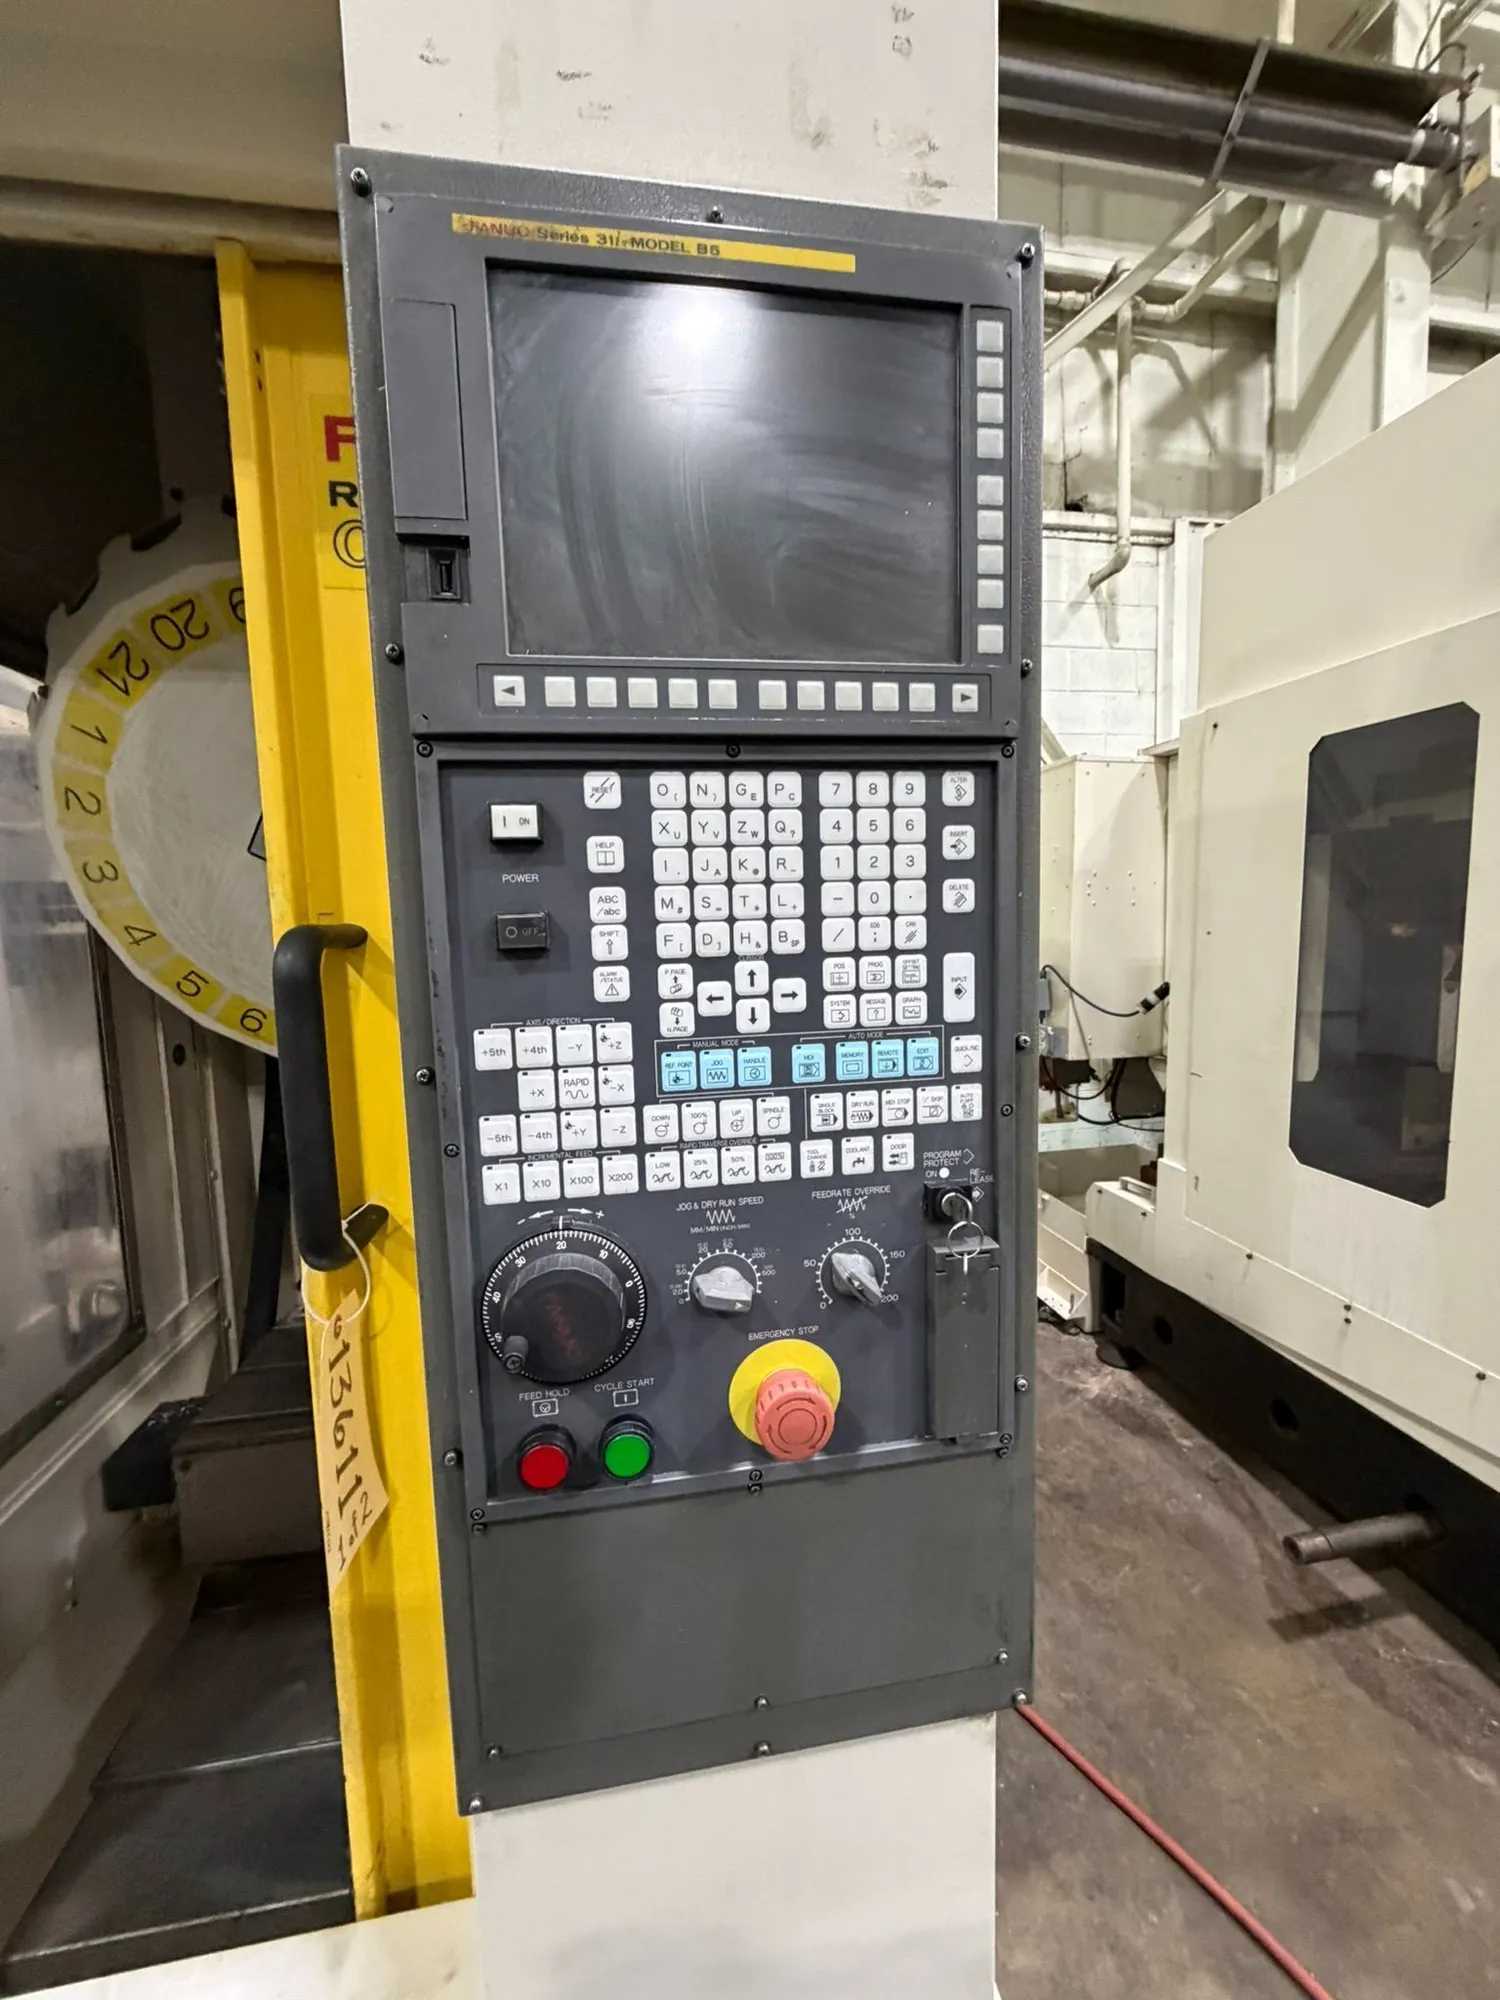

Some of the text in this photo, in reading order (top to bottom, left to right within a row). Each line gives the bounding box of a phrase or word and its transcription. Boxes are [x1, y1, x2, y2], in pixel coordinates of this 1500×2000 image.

[149, 597, 211, 652] 20
[96, 639, 151, 698] 21
[70, 722, 108, 746] 1
[832, 783, 841, 795] 7
[868, 783, 878, 795] 8
[905, 783, 914, 795] 9
[64, 786, 101, 818] 2
[519, 817, 531, 826] ON
[832, 820, 842, 832] 4
[869, 819, 878, 832] 5
[905, 819, 914, 831] 6
[595, 841, 615, 849] HELP
[869, 856, 879, 868] 2
[905, 855, 915, 867] 3
[81, 860, 120, 886] 3
[502, 873, 540, 883] POWER
[597, 896, 619, 904] ABC
[870, 892, 879, 904] 0
[122, 923, 160, 948] 4
[176, 969, 211, 999] 5
[692, 1040, 719, 1048] MANUAL
[522, 1046, 547, 1055] +4th
[564, 1078, 590, 1087] RAPID
[575, 1150, 593, 1158] FEED
[923, 1150, 962, 1160] PROGRAM
[923, 1158, 960, 1168] PROTECT
[570, 1175, 594, 1185] X100
[608, 1172, 633, 1182] X200
[532, 1179, 551, 1189] X10
[811, 1185, 891, 1199] FEEDRATE OVERRIDE
[676, 1202, 692, 1212] JOG
[701, 1199, 717, 1209] DRY
[719, 1198, 736, 1208] RUN
[738, 1196, 764, 1205] SPEED
[845, 1227, 861, 1236] 100
[556, 1240, 567, 1250] 20
[599, 1249, 609, 1260] 10
[515, 1256, 528, 1268] 30
[803, 1259, 817, 1268] 50
[492, 1291, 502, 1303] 40
[748, 1325, 819, 1341] EMERGENCY STOP
[594, 1377, 656, 1393] CYCLE START
[519, 1388, 570, 1402] FEED HOLD
